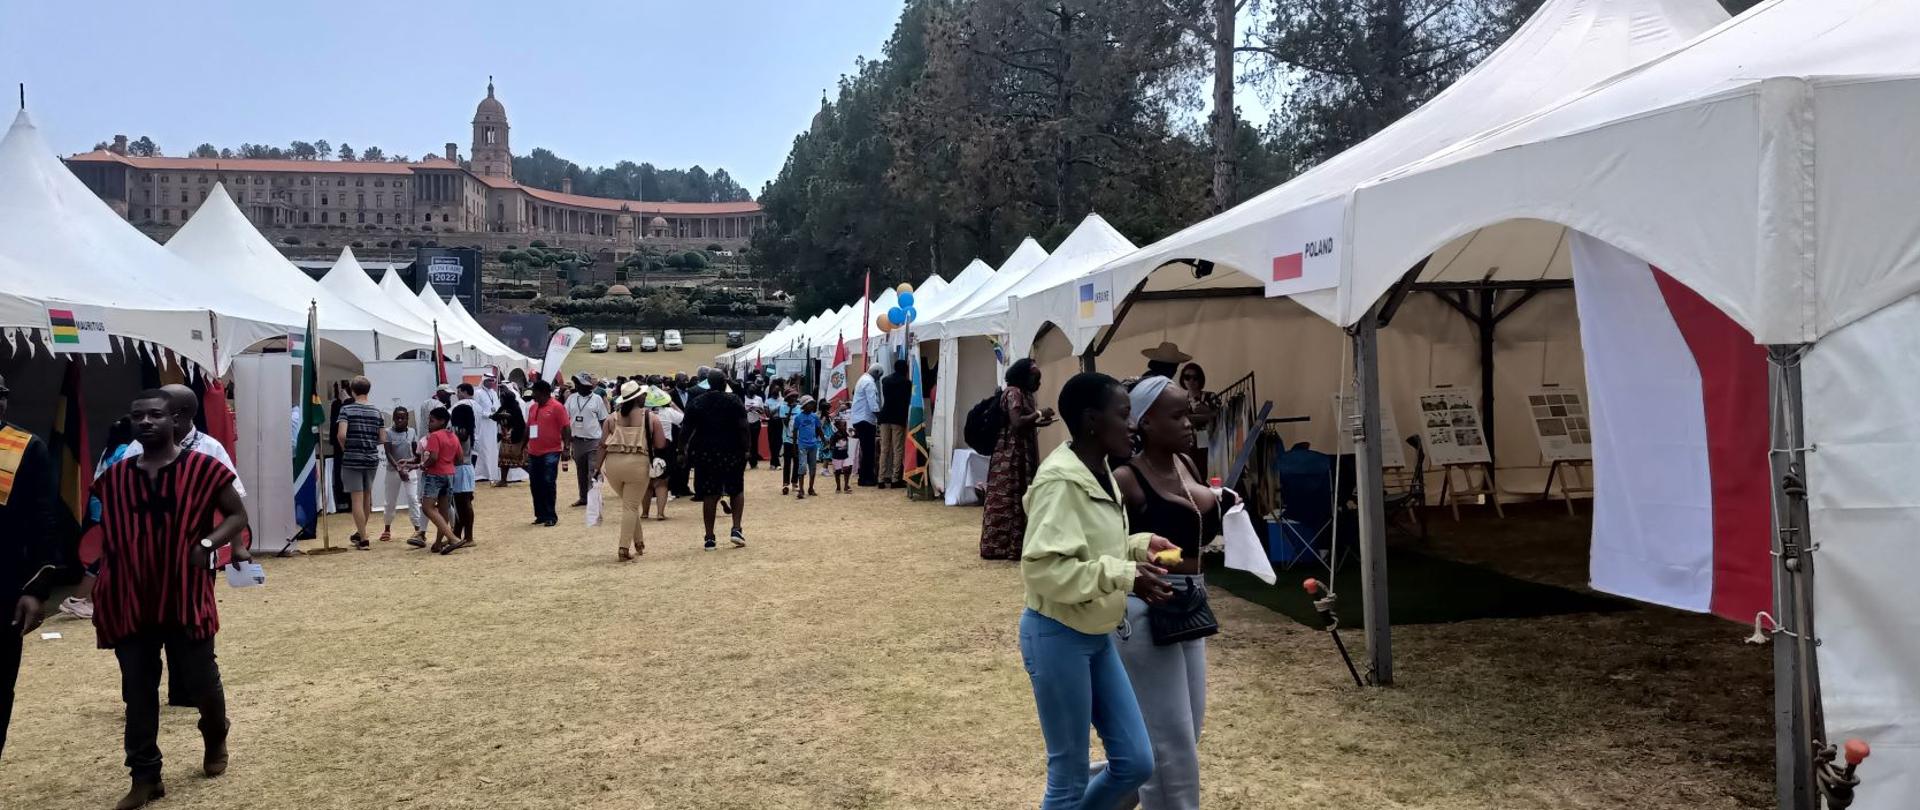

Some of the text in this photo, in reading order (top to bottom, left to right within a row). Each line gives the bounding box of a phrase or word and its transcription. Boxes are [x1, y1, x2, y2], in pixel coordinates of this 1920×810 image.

[1304, 237, 1333, 258] POLAND
[434, 273, 456, 281] 2022
[76, 320, 105, 332] MAURITIUS
